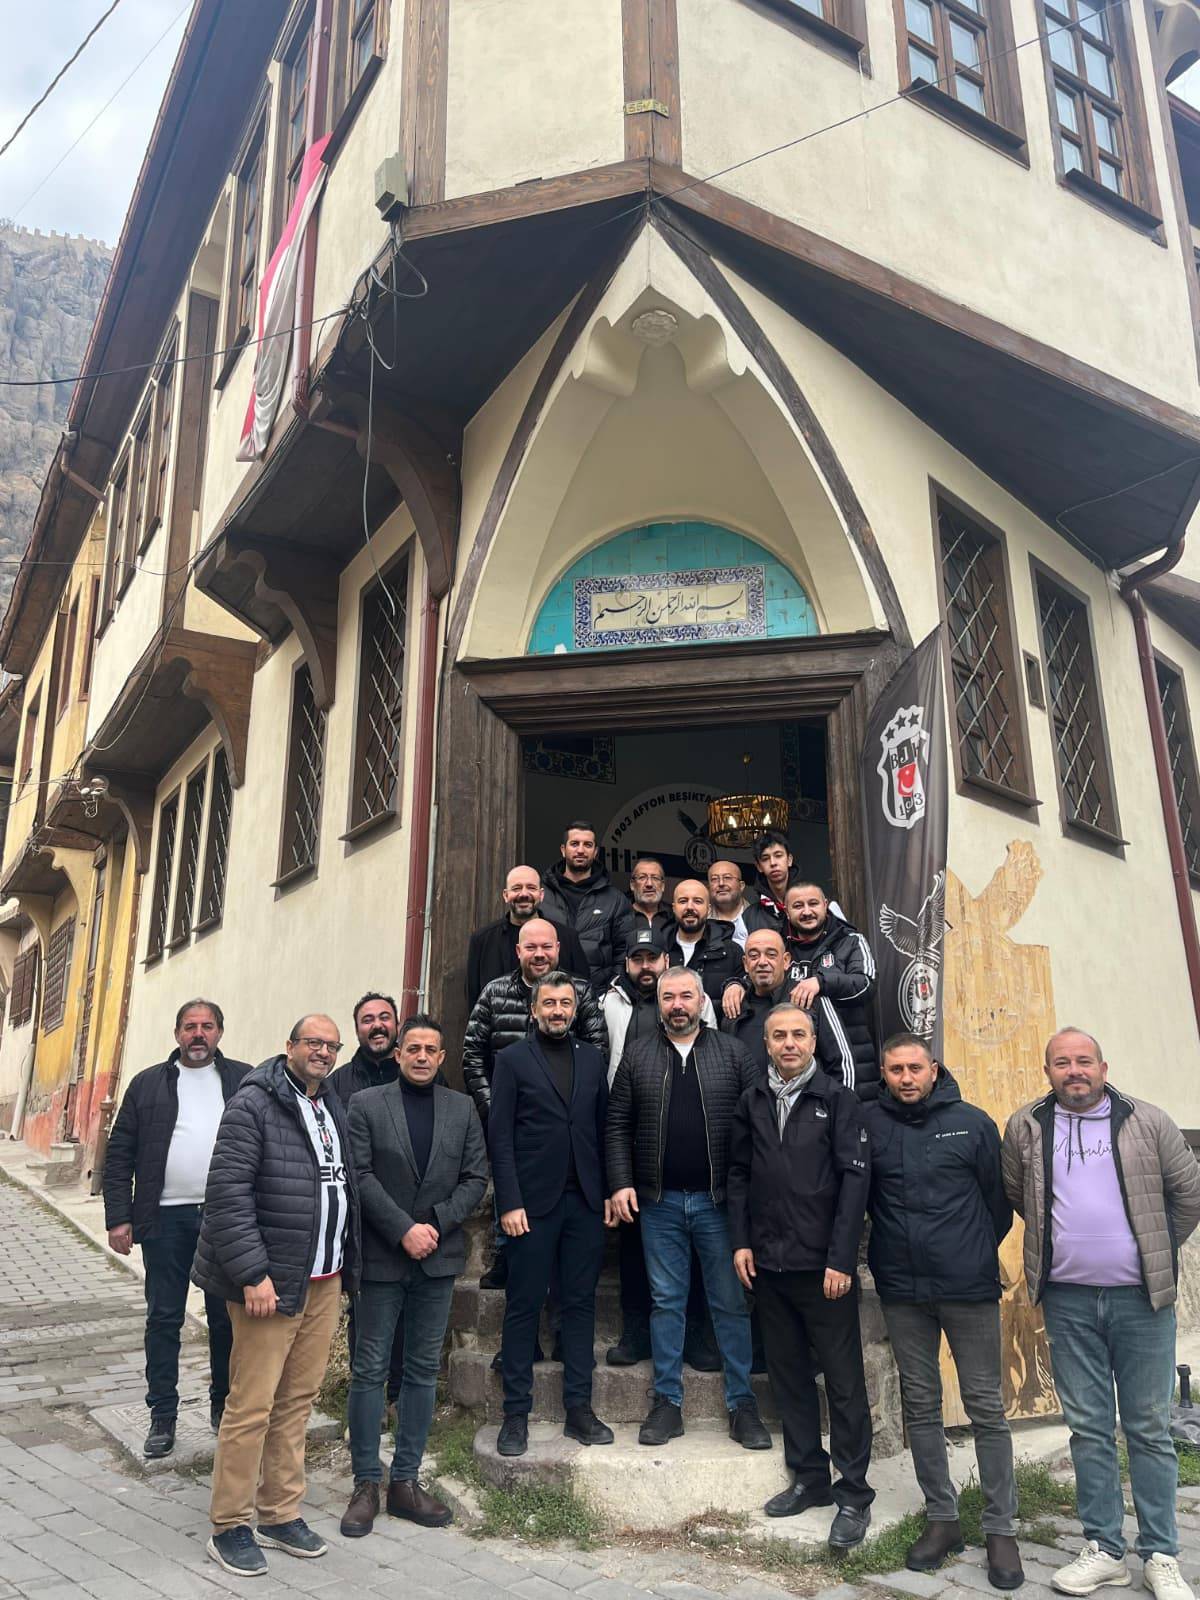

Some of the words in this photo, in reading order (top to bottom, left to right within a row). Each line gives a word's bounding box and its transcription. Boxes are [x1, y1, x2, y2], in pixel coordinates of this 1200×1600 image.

[696, 589, 743, 622] بسم
[611, 816, 632, 844] 1903
[632, 794, 666, 819] AFYON
